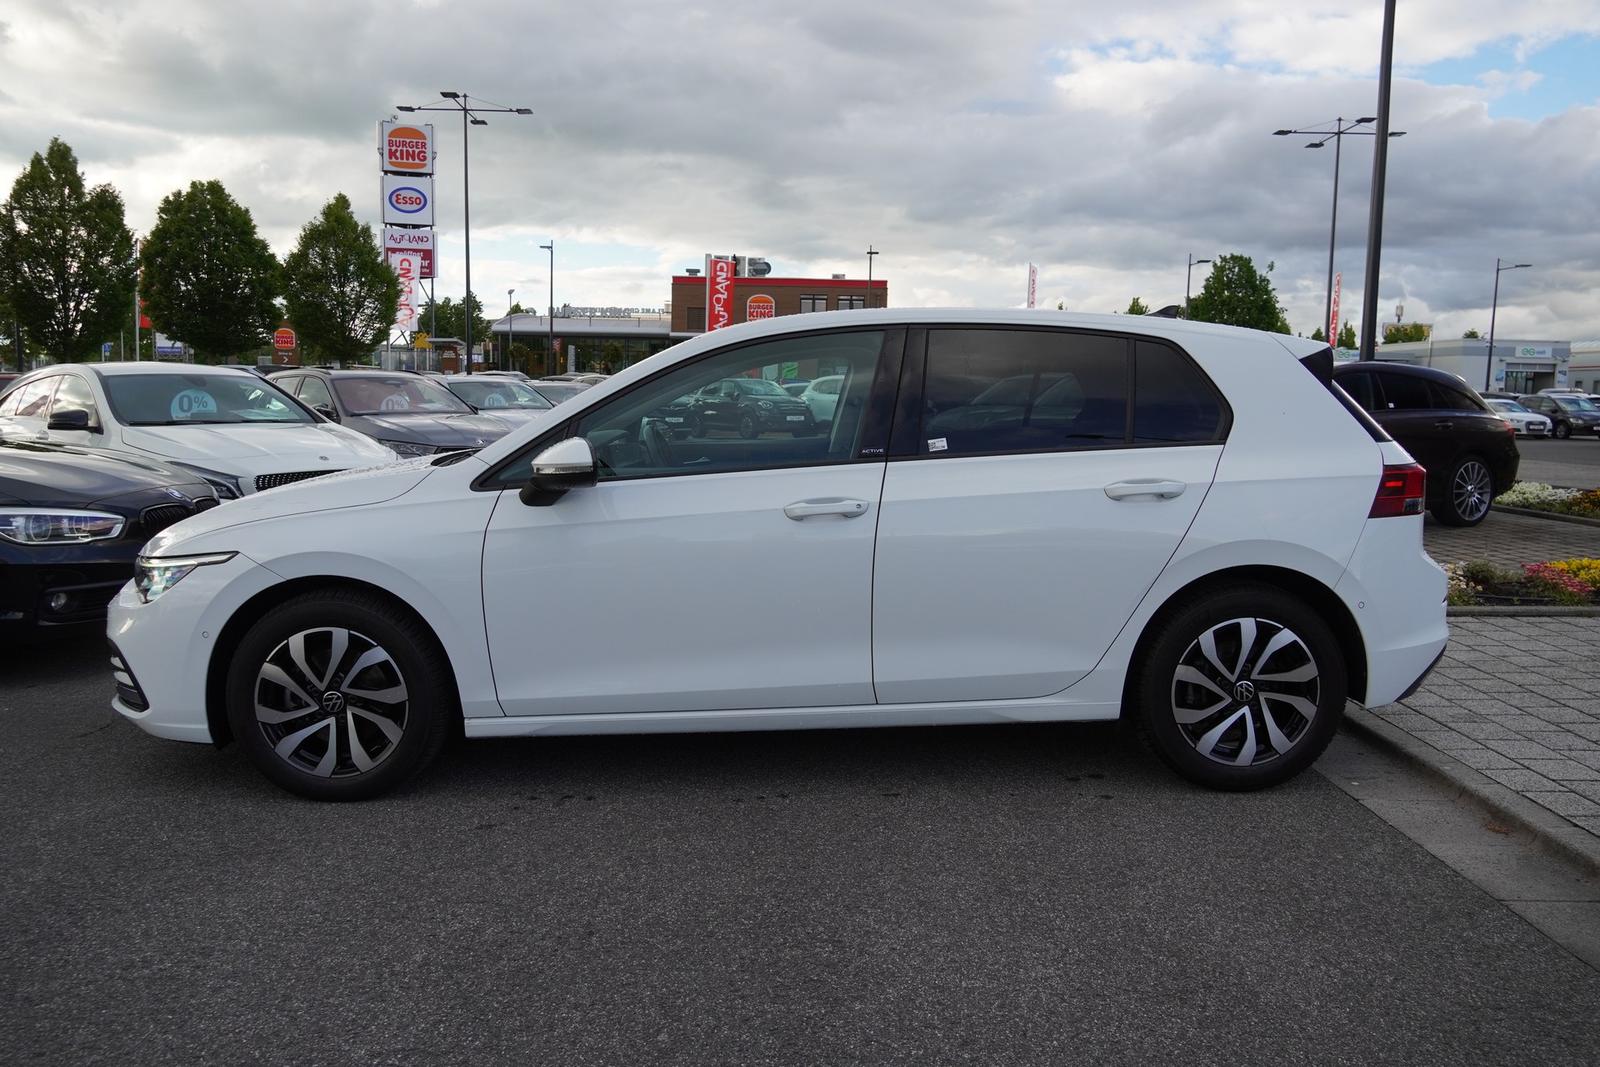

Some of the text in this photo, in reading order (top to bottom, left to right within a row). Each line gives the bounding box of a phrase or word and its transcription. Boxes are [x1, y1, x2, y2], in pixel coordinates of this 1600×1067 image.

[388, 139, 427, 150] BURGER
[388, 148, 427, 162] KING
[748, 310, 773, 318] KING
[179, 394, 208, 413] 0%
